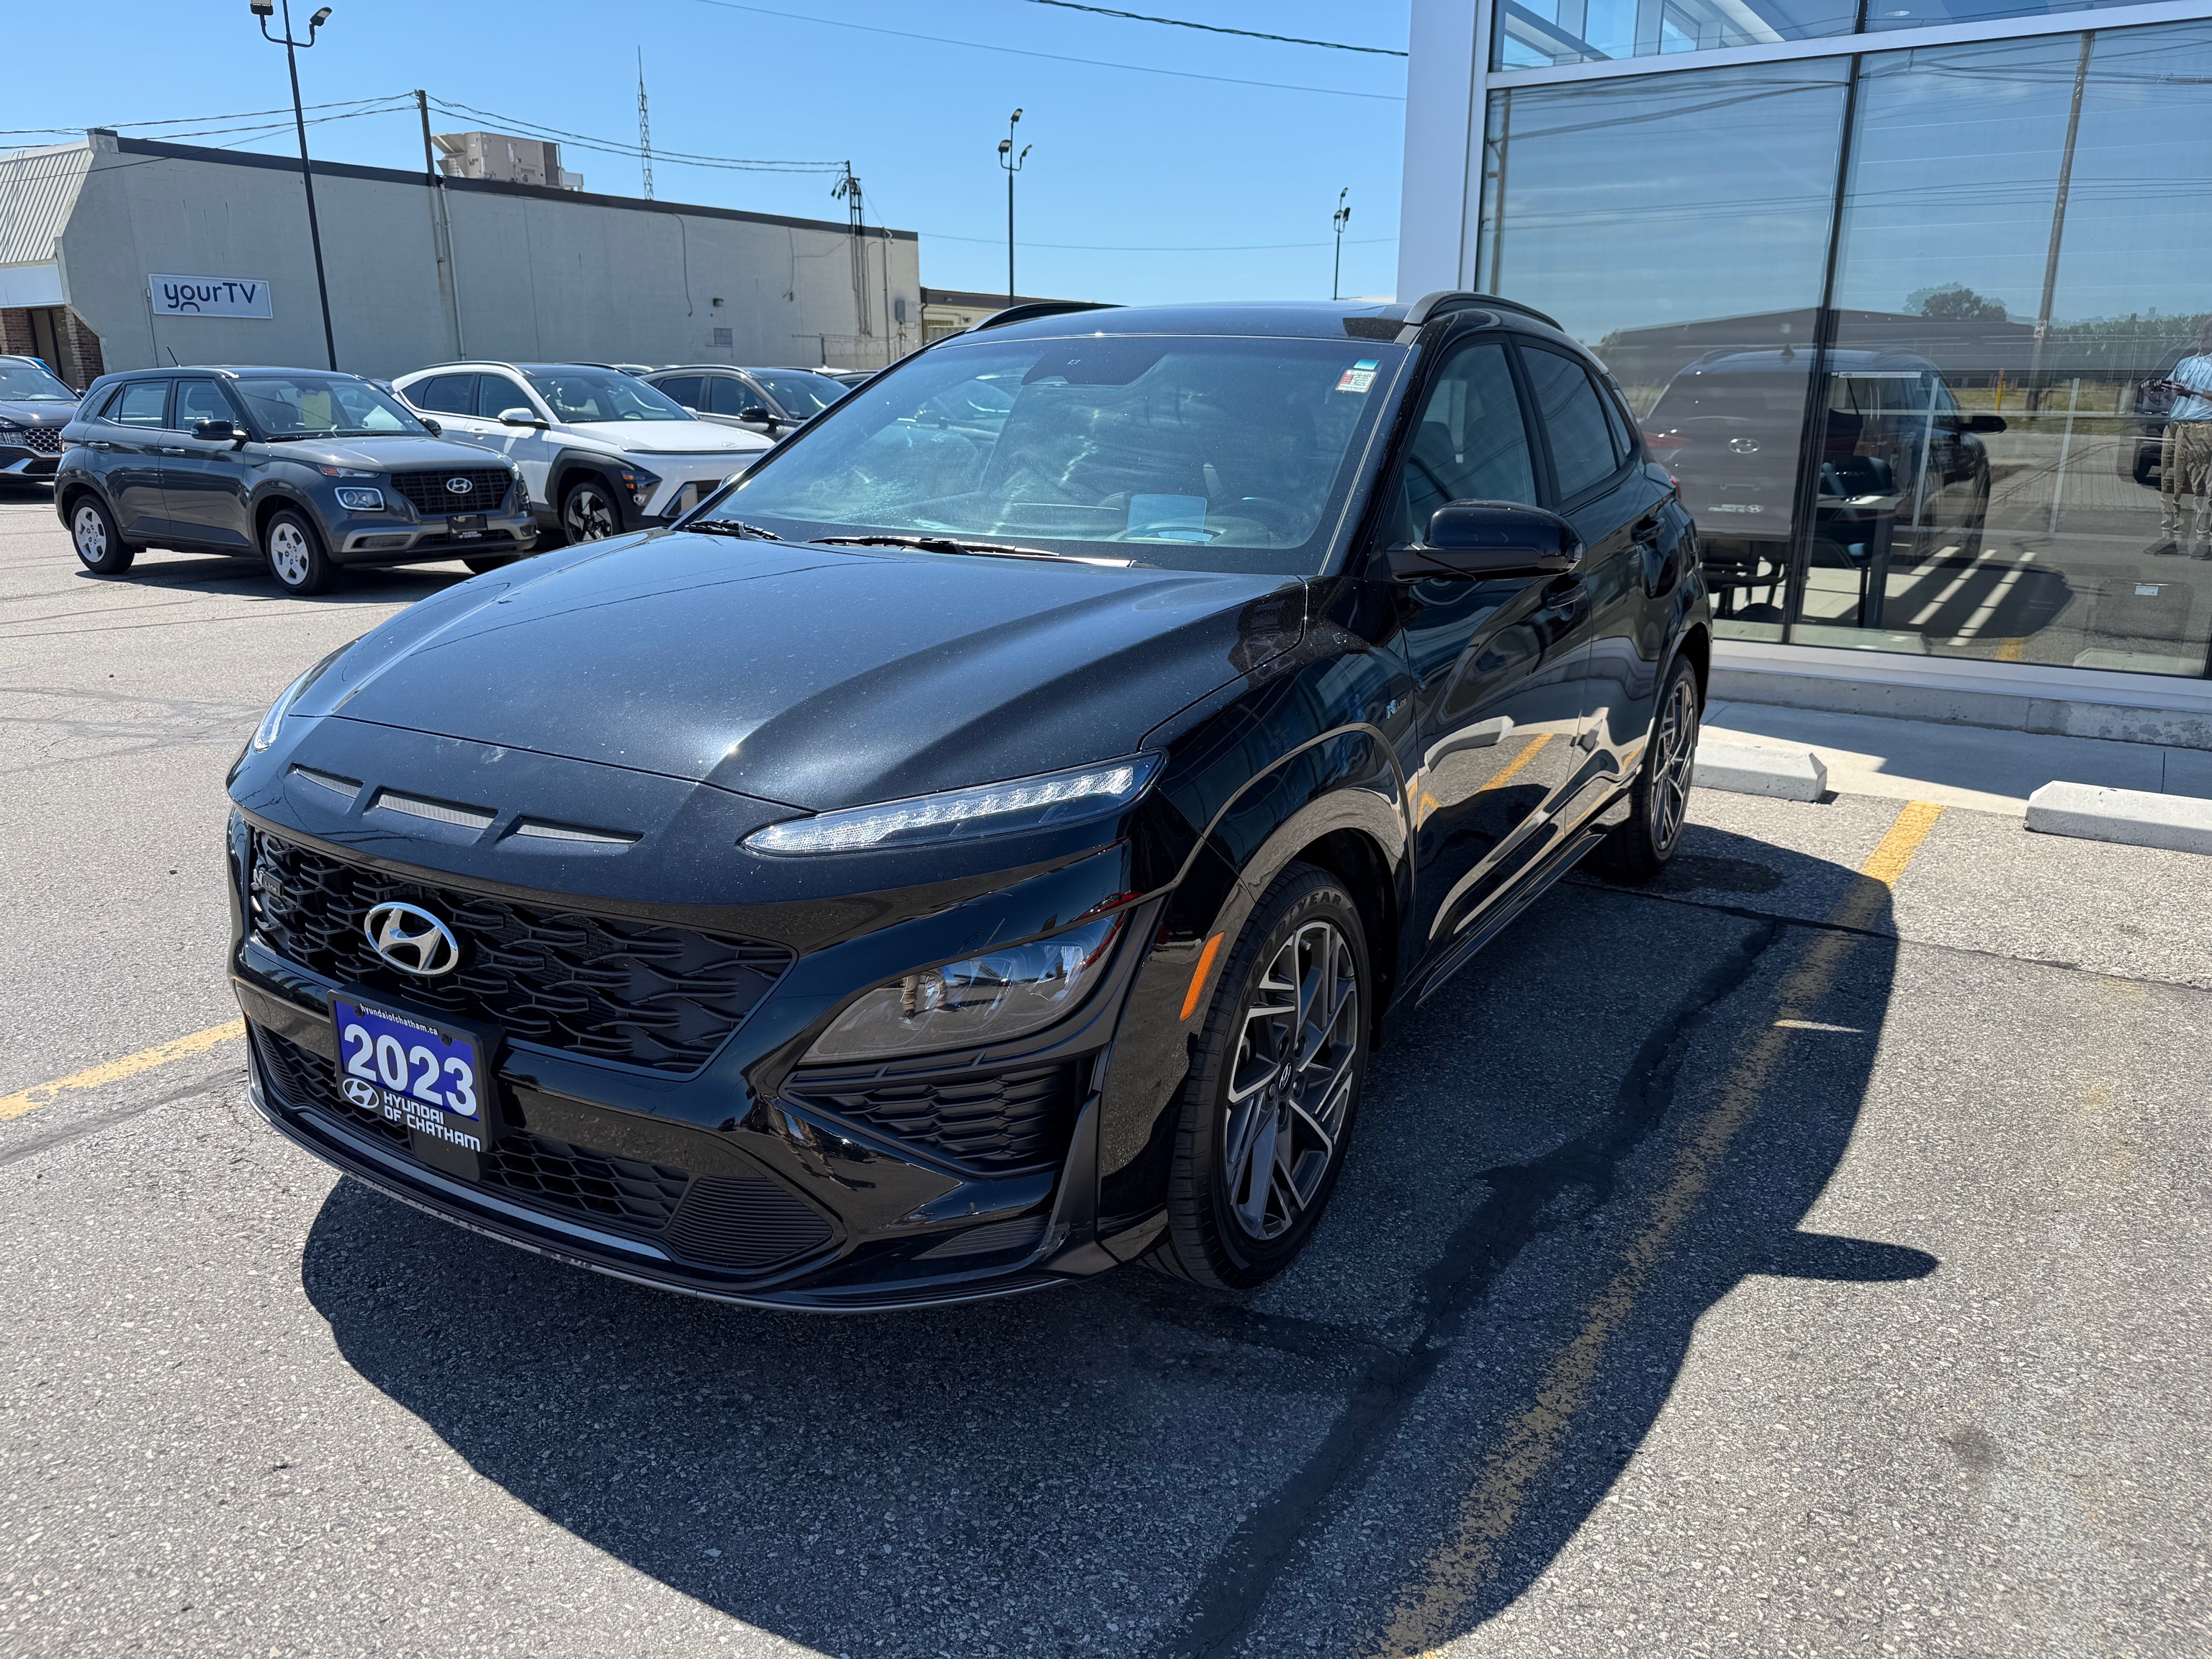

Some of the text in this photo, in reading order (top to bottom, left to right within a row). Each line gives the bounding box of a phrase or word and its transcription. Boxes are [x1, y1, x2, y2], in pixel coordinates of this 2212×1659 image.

[164, 282, 256, 311] yourTV
[360, 1003, 439, 1035] hyundaiofchatham.ca
[344, 1023, 477, 1116] 2023
[383, 1091, 444, 1125] HYUNDAI
[384, 1105, 481, 1151] OF CHATHAM
